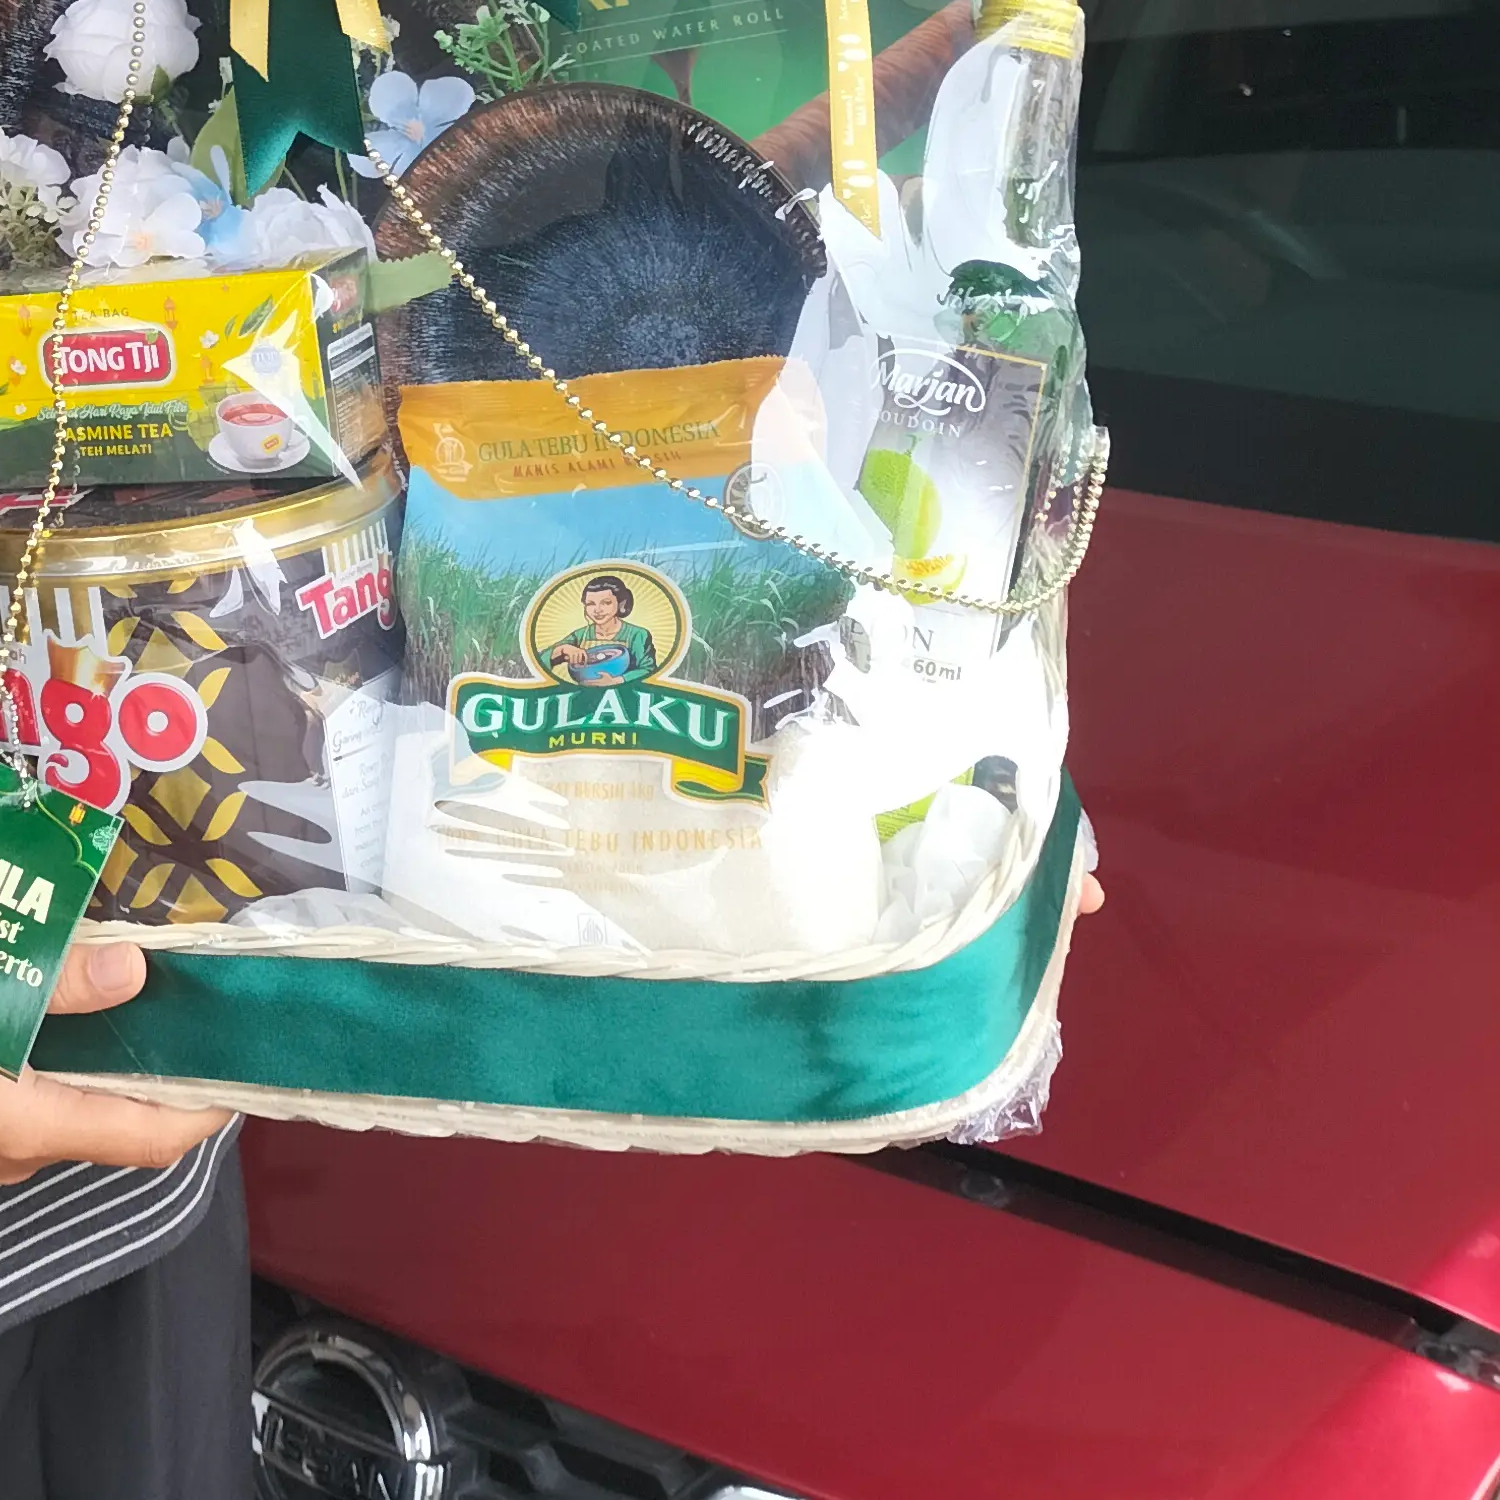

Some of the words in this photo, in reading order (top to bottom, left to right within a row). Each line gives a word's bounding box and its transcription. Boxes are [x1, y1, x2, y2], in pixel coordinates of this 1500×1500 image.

[652, 17, 720, 41] WAFER
[732, 7, 785, 27] ROLL
[102, 306, 129, 318] BAG
[59, 345, 125, 375] TONG
[125, 341, 160, 373] TJI
[872, 358, 986, 417] Marjan
[64, 424, 134, 443] ASMINE
[137, 422, 174, 439] TEA
[879, 409, 962, 438] OUDOIN
[79, 445, 103, 457] TEH
[106, 443, 153, 456] MELATI
[478, 439, 536, 462] GULA
[537, 433, 589, 457] TEBU
[513, 463, 560, 479] MANIS
[568, 457, 616, 473] ALAMI
[462, 688, 737, 748] GULAKU
[549, 732, 637, 749] MURNI
